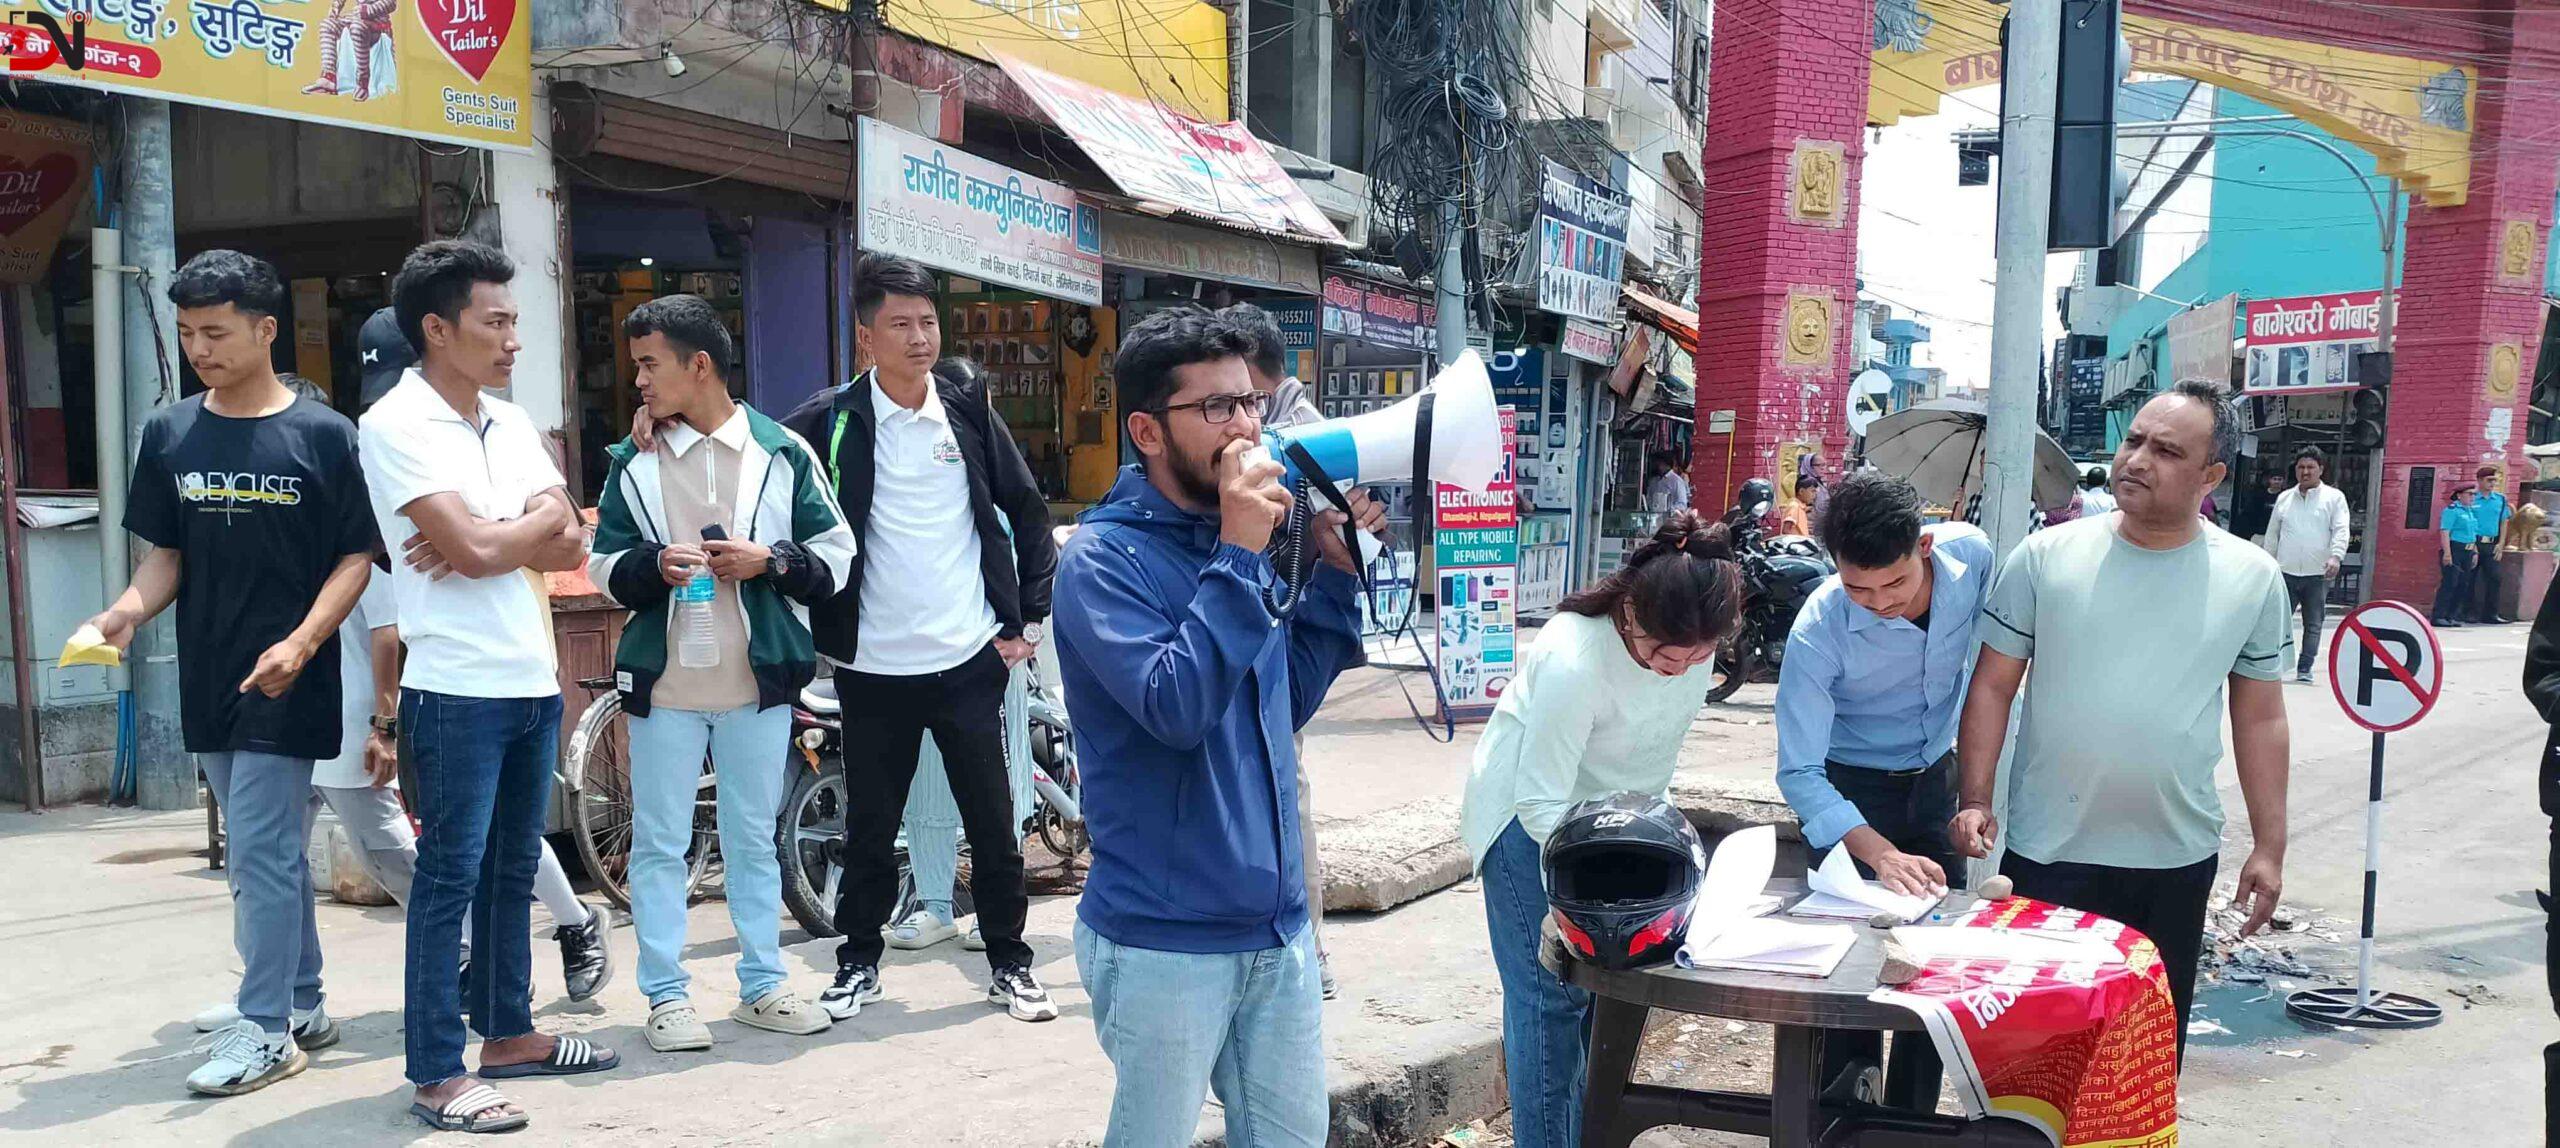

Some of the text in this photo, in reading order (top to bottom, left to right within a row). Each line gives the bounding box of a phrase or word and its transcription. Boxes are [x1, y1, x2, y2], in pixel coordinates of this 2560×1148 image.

[441, 27, 498, 51] Tailor's
[443, 88, 517, 113] Gents Suit
[446, 107, 516, 131] Specialist
[903, 149, 1073, 238] राजीव कम्युनिकेशन
[2252, 303, 2326, 338] बागेश्वरी
[1440, 490, 1514, 507] ELECTRONICS
[1439, 530, 1514, 545] ALL TYPE MOBILE
[1453, 549, 1502, 563] REPAIRING
